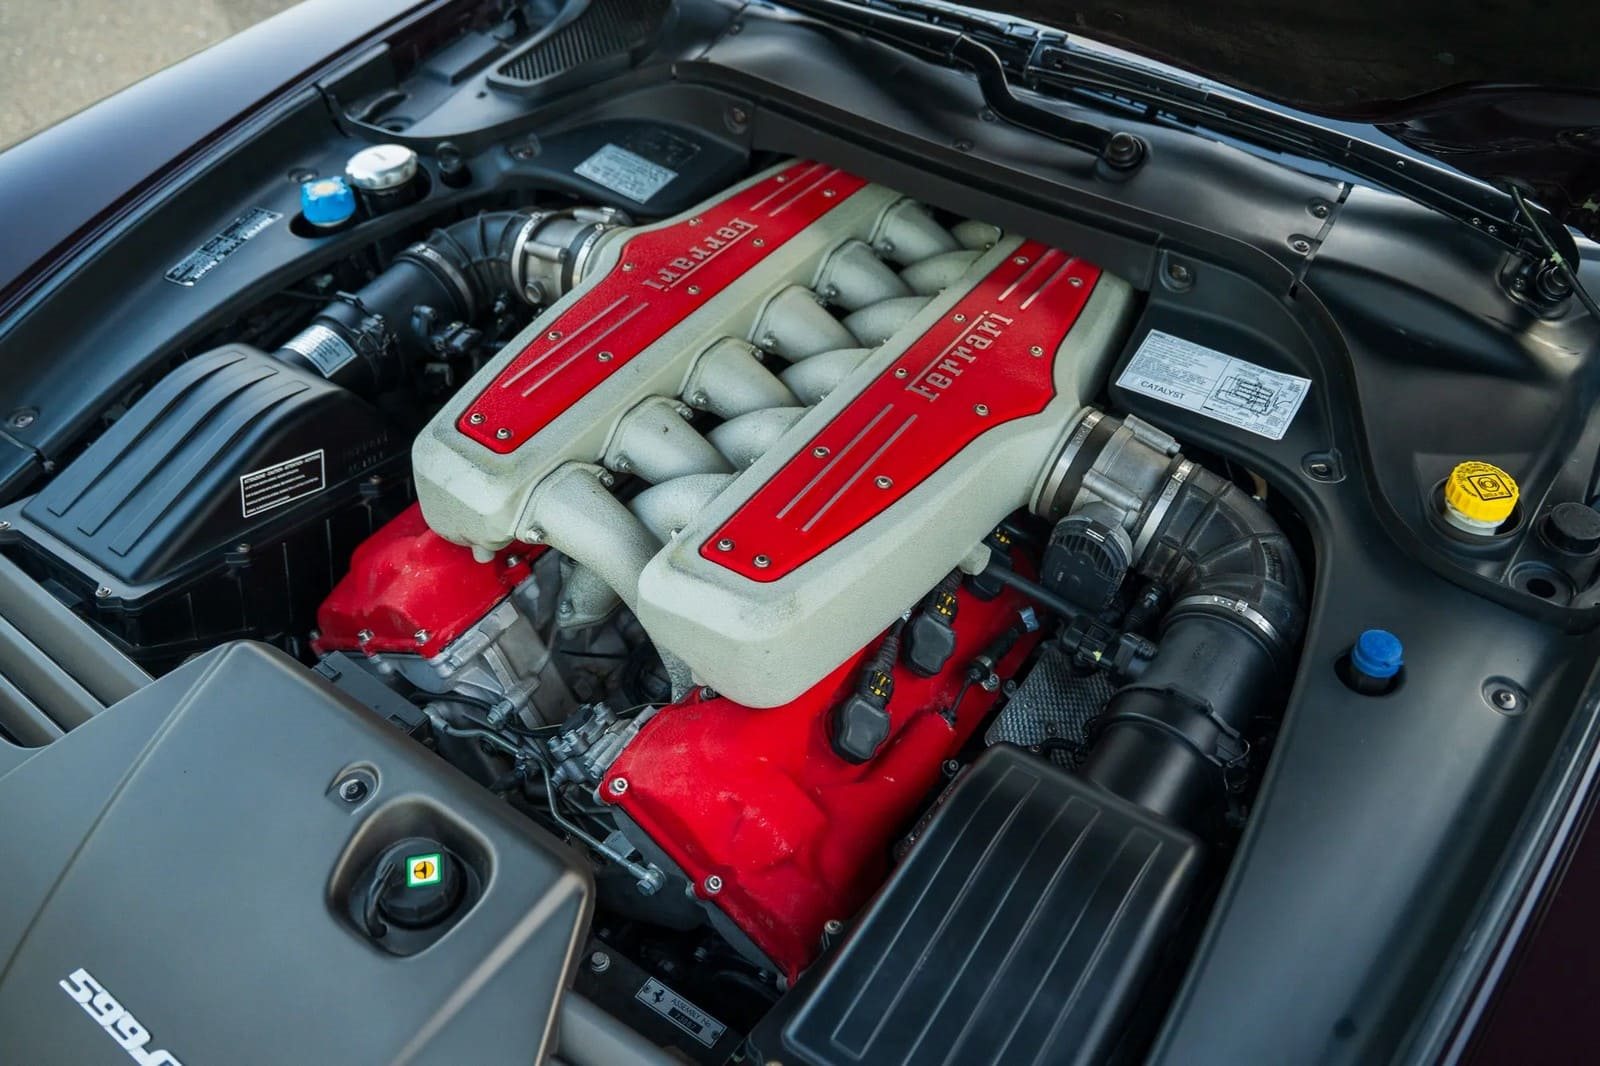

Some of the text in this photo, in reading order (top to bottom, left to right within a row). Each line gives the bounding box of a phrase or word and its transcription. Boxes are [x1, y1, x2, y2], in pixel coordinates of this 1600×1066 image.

[641, 217, 759, 292] Ferrari
[905, 310, 1014, 402] Ferrari
[1140, 380, 1185, 402] CATALYST
[59, 967, 152, 1051] 599
[671, 997, 701, 1018] ASSEMBLY
